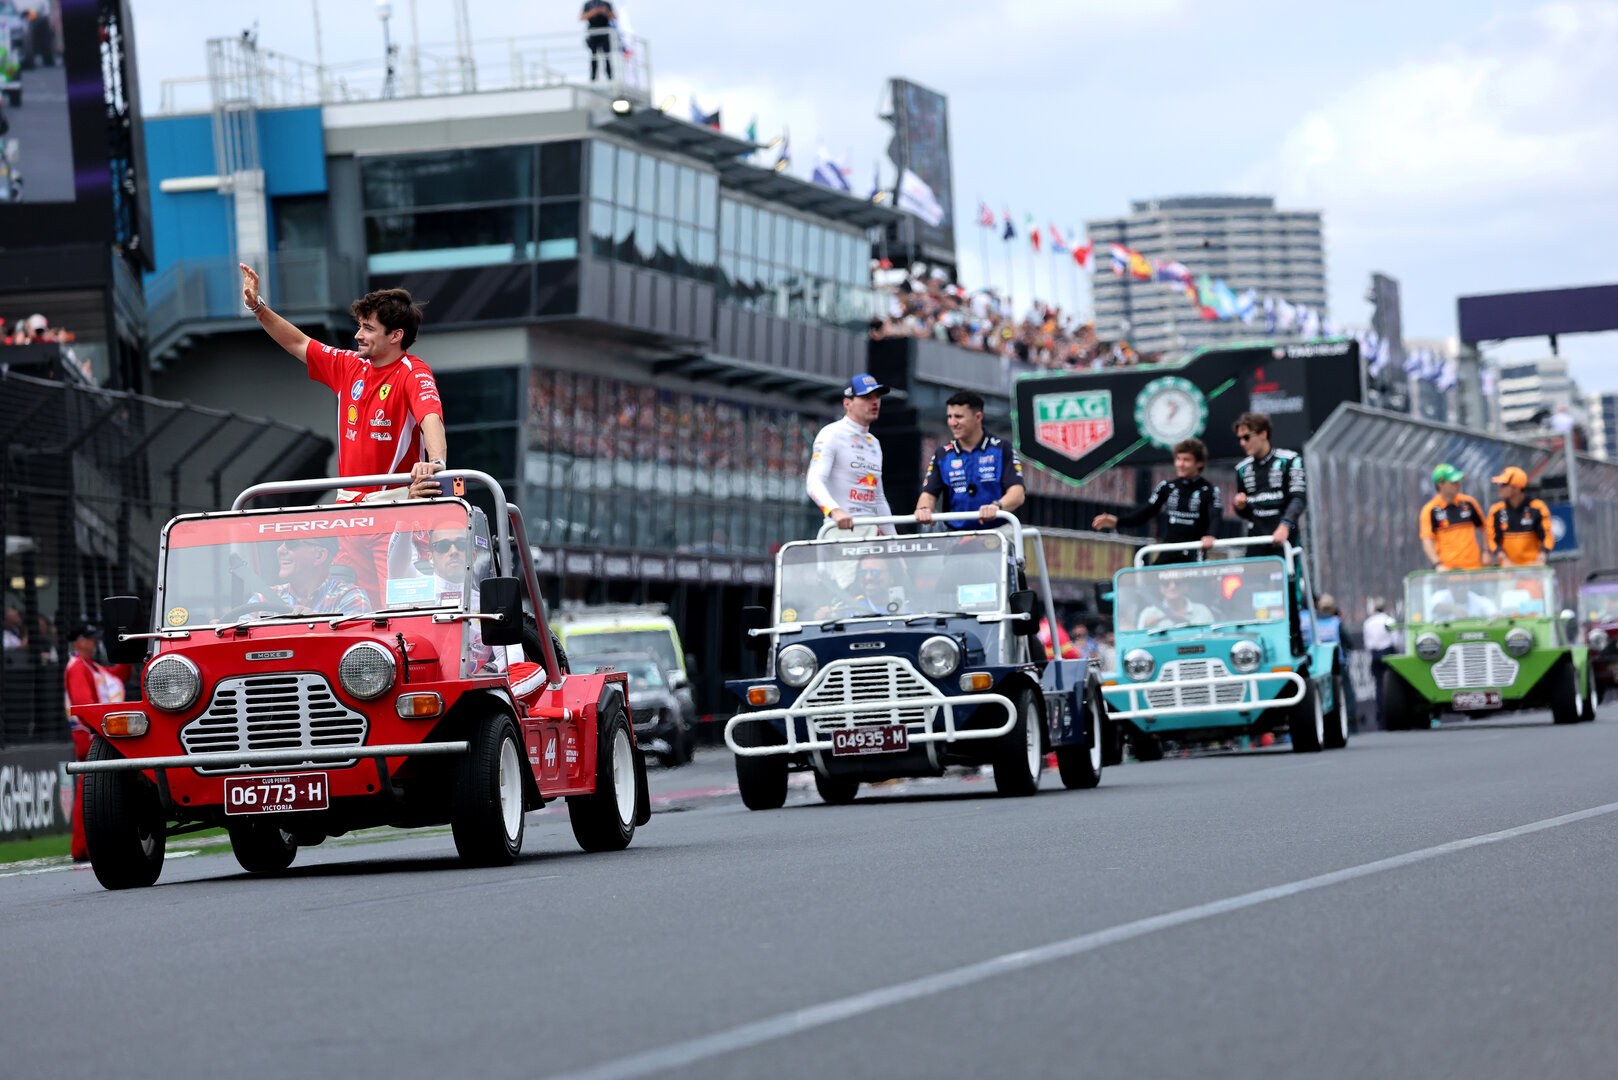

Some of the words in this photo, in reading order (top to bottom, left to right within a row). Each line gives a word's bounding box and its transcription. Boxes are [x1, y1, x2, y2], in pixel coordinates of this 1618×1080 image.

[1041, 396, 1104, 420] TAG
[258, 517, 375, 534] FERRARI
[842, 546, 885, 556] RED
[887, 542, 940, 554] BULL
[544, 737, 557, 767] 44
[262, 804, 293, 812] VICTORIA
